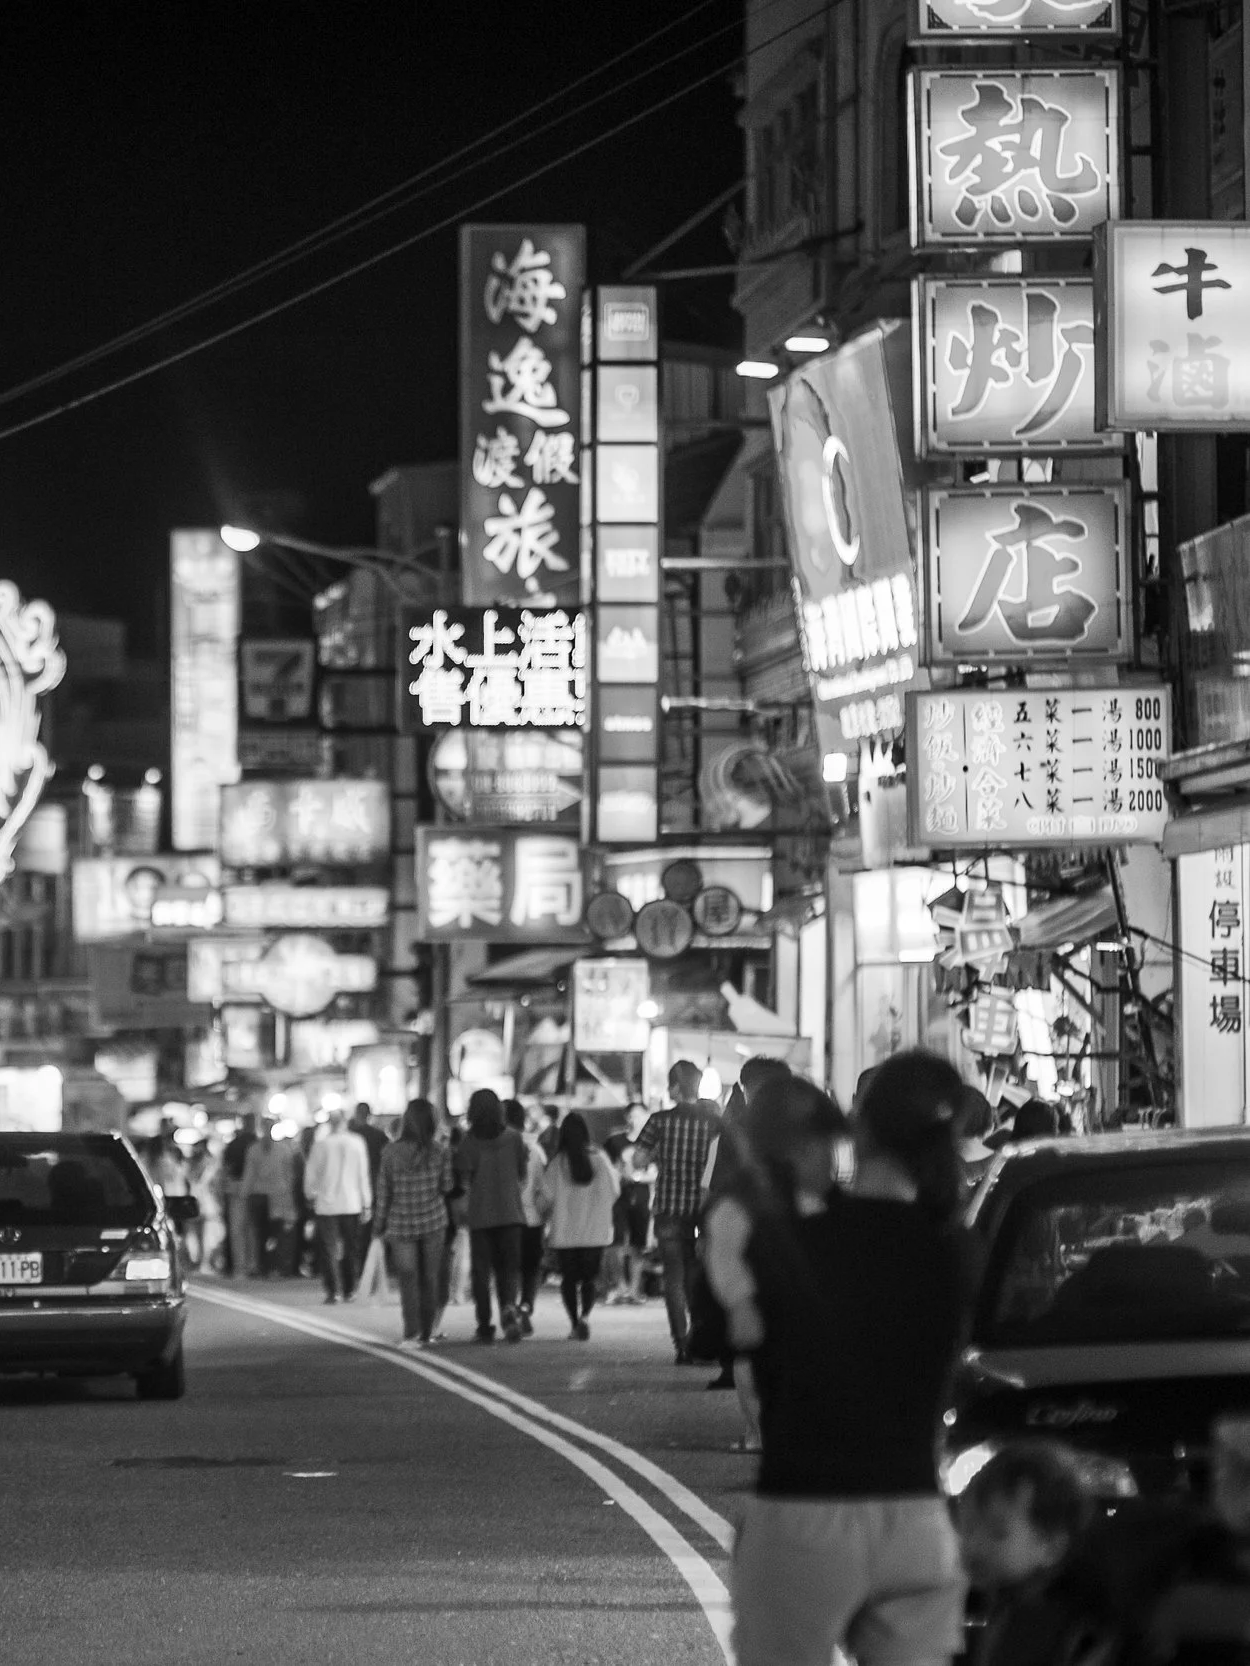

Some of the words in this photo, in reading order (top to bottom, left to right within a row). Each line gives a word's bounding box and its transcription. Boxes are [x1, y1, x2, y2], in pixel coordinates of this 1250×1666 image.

[409, 610, 586, 668] 水上活
[1013, 697, 1123, 724] 五菜一湯
[1135, 697, 1161, 721] 800
[1013, 728, 1123, 753] 六菜一湯
[1129, 728, 1162, 751] 1000
[1013, 757, 1123, 783] 七菜一湯
[1013, 787, 1123, 814] 八菜一湯
[1129, 789, 1162, 813] 2000
[427, 837, 583, 928] 藥局
